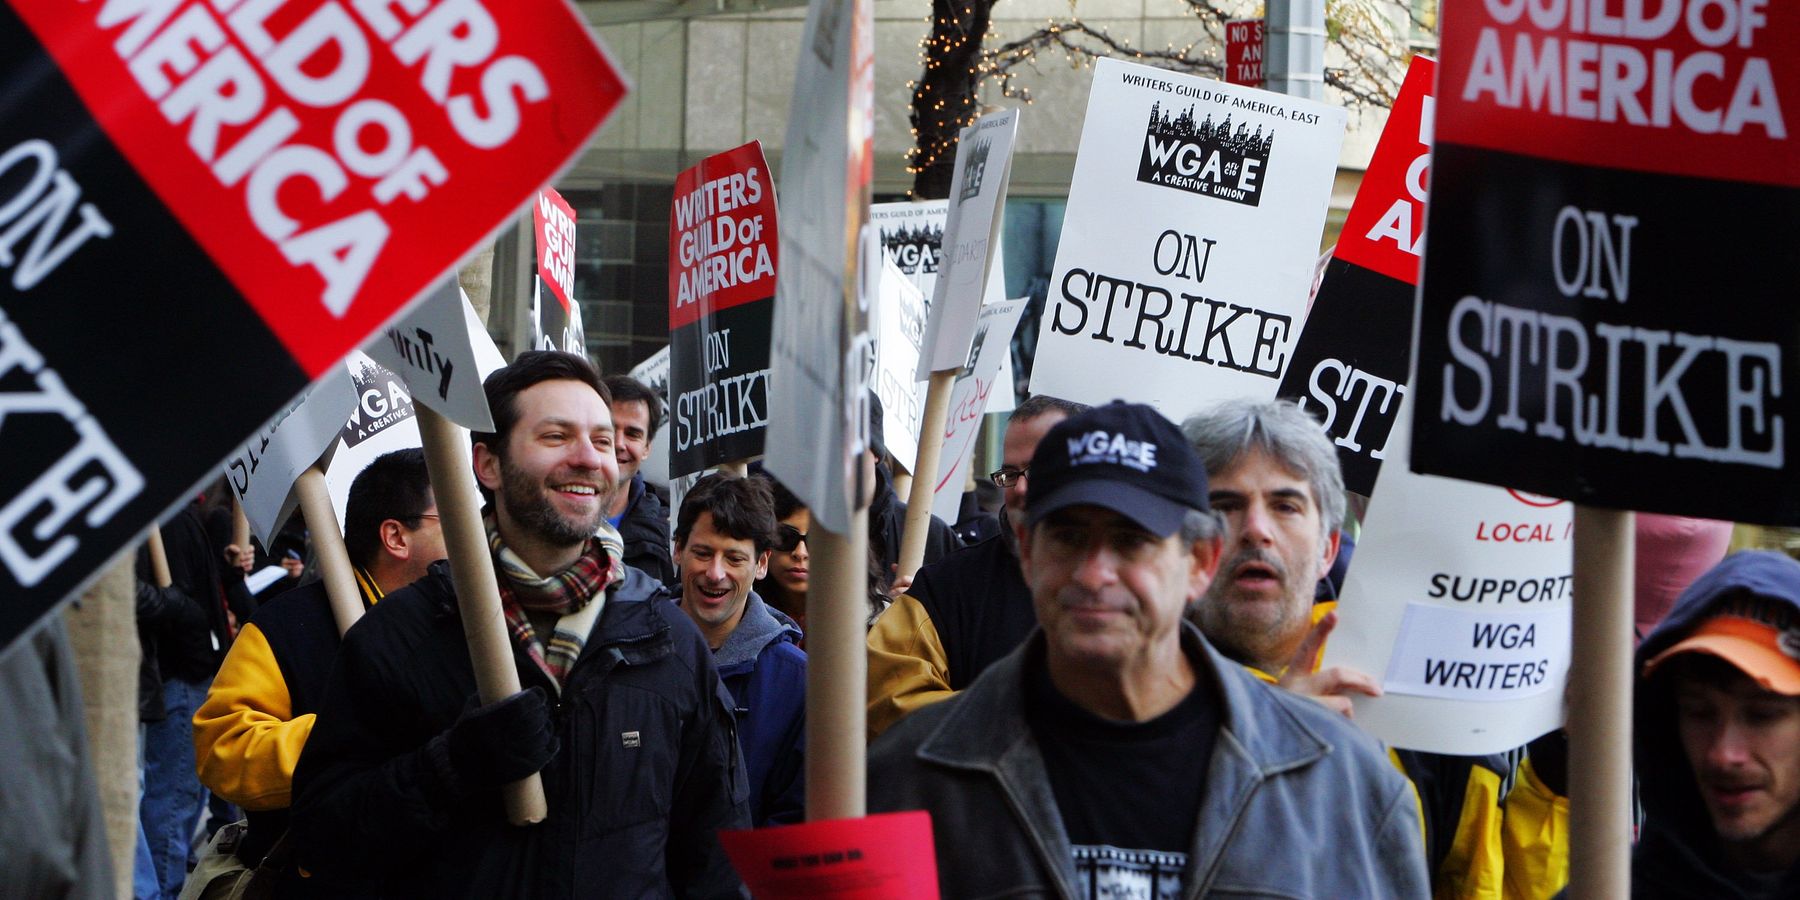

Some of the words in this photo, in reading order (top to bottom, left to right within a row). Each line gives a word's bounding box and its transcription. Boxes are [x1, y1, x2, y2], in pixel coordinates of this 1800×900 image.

[1231, 26, 1248, 43] NO
[1686, 0, 1770, 48] OF
[1241, 44, 1261, 62] AN
[1121, 73, 1173, 93] WRITERS
[1175, 84, 1211, 101] GUILD
[1214, 93, 1230, 105] OF
[1231, 97, 1288, 120] AMERICA,
[1291, 110, 1320, 126] EAST
[1462, 26, 1787, 140] AMERICA
[334, 99, 449, 204] OF
[674, 167, 763, 232] WRITERS
[890, 206, 914, 217] GUILD
[915, 205, 924, 216] OF
[1152, 171, 1161, 182] A
[1164, 174, 1209, 192] CREATIVE
[1213, 184, 1246, 201] UNION
[0, 139, 114, 291] ON
[679, 215, 737, 268] GUILD
[737, 214, 764, 246] OF
[676, 243, 775, 308] AMERICA
[1153, 229, 1217, 283] ON
[1552, 205, 1639, 304] ON
[1051, 267, 1292, 380] STRIKE
[705, 328, 731, 374] ON
[1441, 296, 1785, 469] STRIKE
[358, 428, 367, 440] A
[367, 406, 408, 433] CREATIVE
[1476, 521, 1555, 543] LOCAL
[1471, 622, 1536, 650] WGA
[1423, 658, 1549, 690] WRITERS
